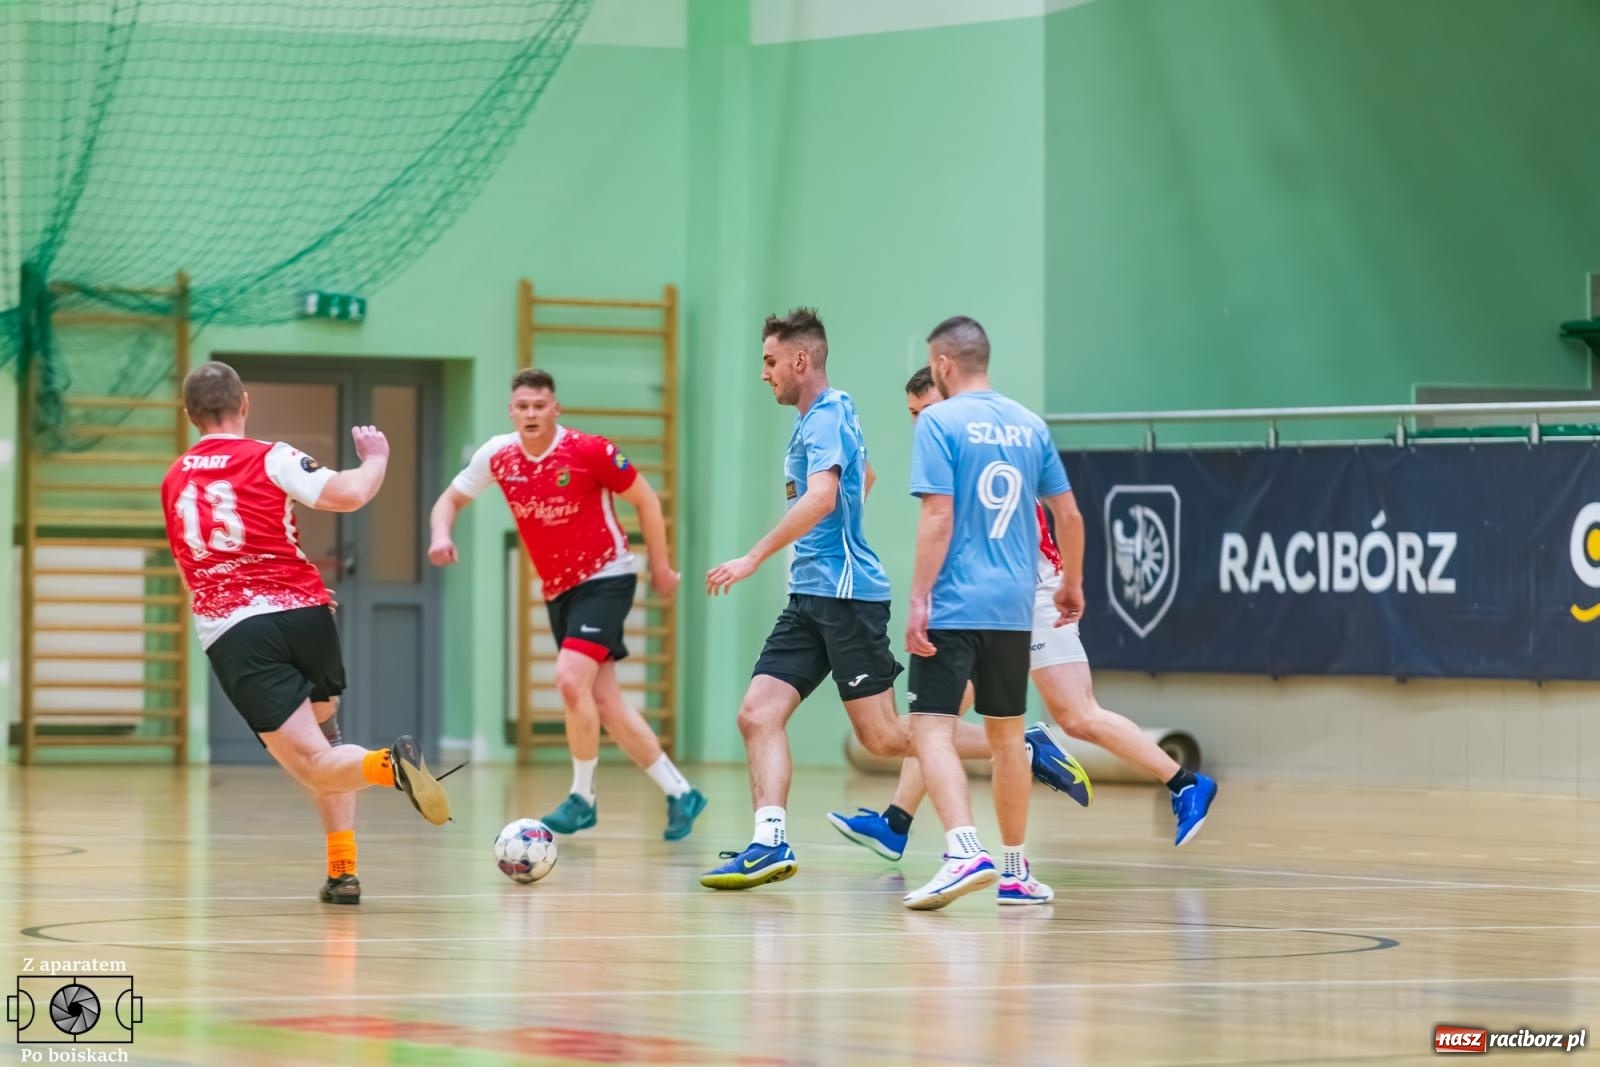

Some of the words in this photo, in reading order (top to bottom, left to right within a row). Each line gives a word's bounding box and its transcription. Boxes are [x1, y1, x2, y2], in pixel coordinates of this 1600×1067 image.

[181, 454, 232, 471] START
[967, 422, 1034, 448] SZARY
[174, 479, 246, 561] 13
[977, 460, 1023, 539] 9
[1219, 510, 1458, 595] RACIBÓRZ
